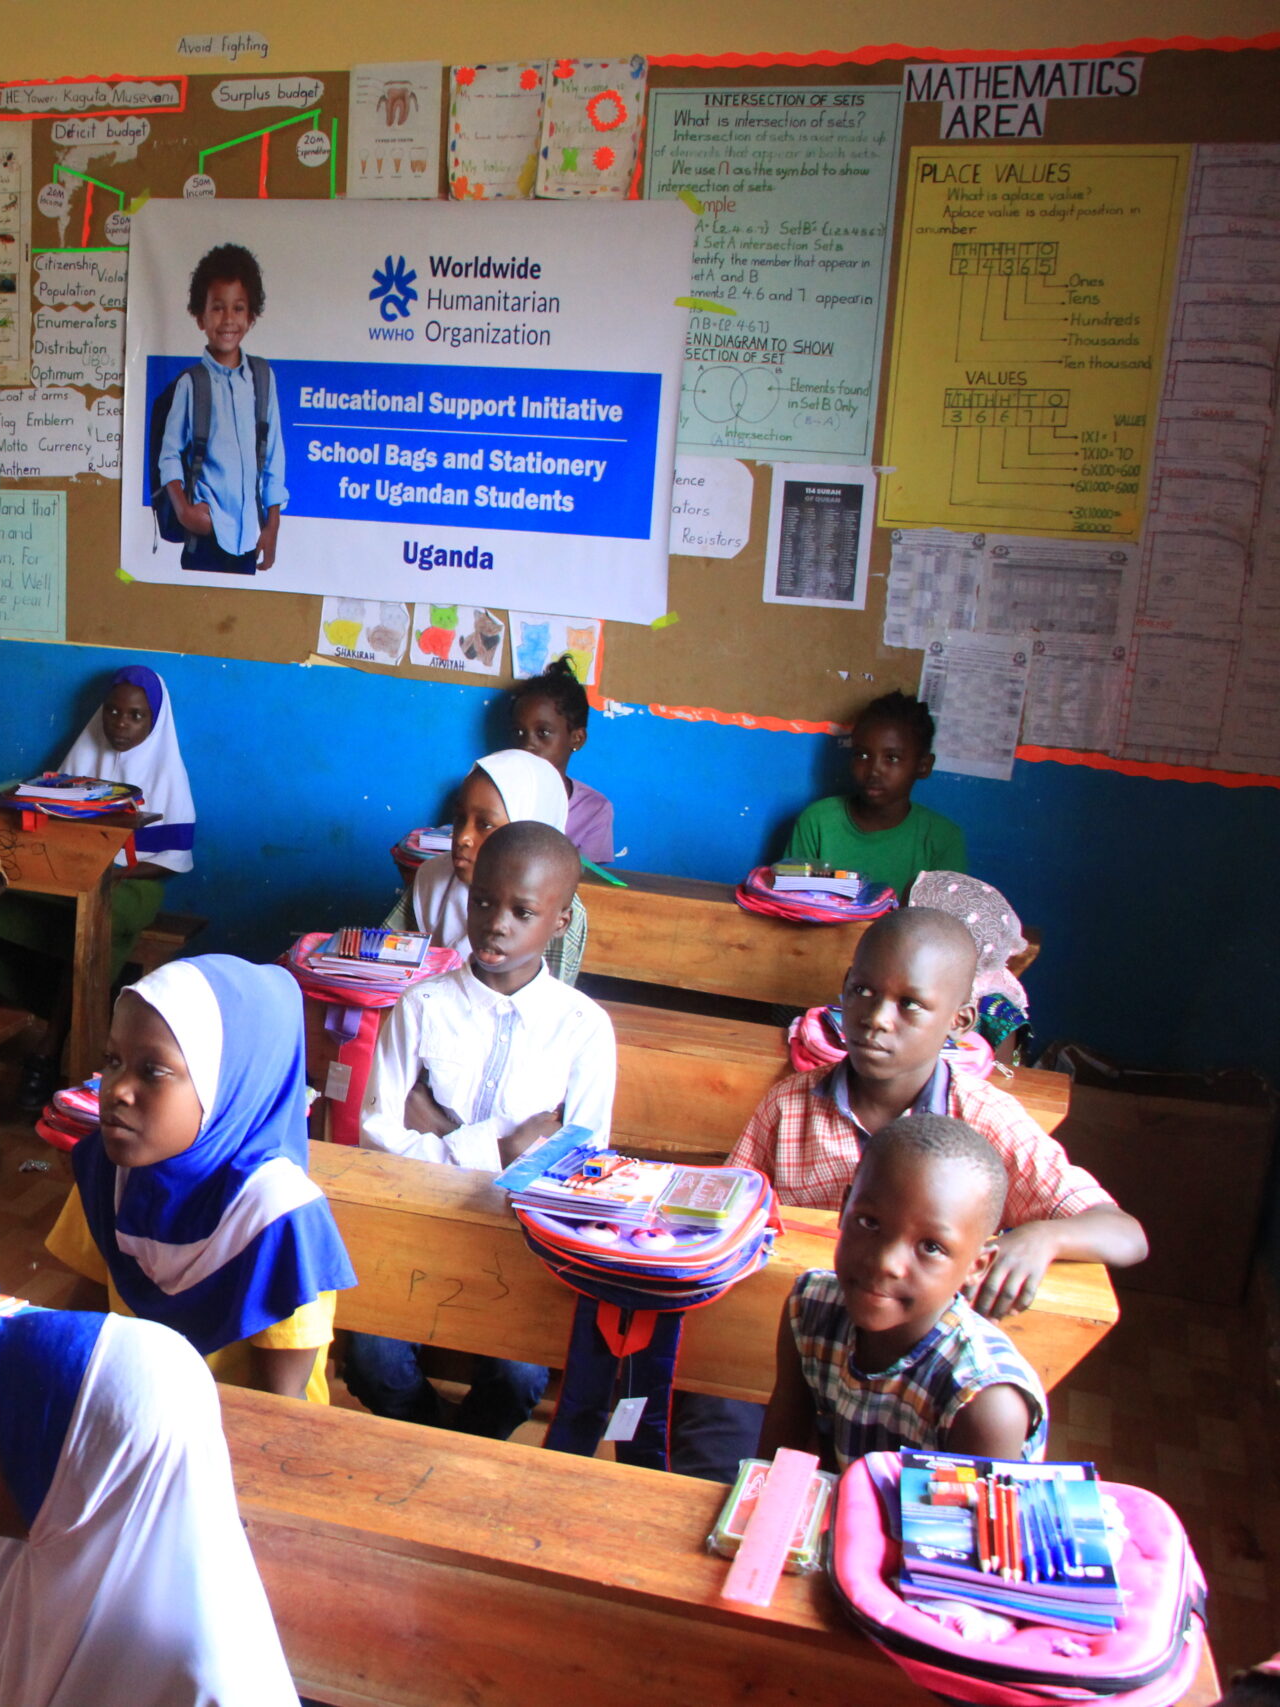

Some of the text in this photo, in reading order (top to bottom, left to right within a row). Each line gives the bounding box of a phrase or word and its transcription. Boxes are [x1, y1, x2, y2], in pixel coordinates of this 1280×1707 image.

[178, 38, 212, 53] Avoid
[906, 60, 1138, 101] MATHEMATICS
[64, 88, 107, 108] Kaguta
[220, 82, 319, 109] Surplus budget
[704, 94, 805, 107] INTERSECTION
[810, 94, 826, 106] OF
[673, 109, 709, 128] What
[718, 116, 729, 127] is
[734, 110, 806, 128] intersection
[945, 102, 1044, 138] AREA
[107, 120, 147, 145] budget
[672, 160, 691, 175] We
[695, 165, 716, 175] use
[775, 161, 819, 179] symbol
[920, 162, 1071, 184] PLACE VALUES
[948, 186, 984, 201] What
[35, 255, 98, 276] Citizenship
[429, 255, 542, 279] Worldwide
[731, 253, 747, 266] the
[751, 256, 792, 268] member
[794, 253, 816, 267] that
[818, 257, 859, 275] appear
[1069, 273, 1104, 287] Ones
[39, 281, 96, 302] Population
[427, 288, 560, 313] Humanitarian
[769, 288, 793, 301] and
[1067, 290, 1101, 305] Tens
[36, 314, 117, 329] Enumerators
[1070, 312, 1140, 327] Hundreds
[369, 327, 415, 341] WWHO
[425, 320, 551, 347] Organization
[1066, 333, 1140, 347] Thousands
[34, 340, 107, 355] Distribution
[714, 335, 834, 356] DIAGRAM TO SHOW
[743, 351, 757, 362] OF
[1063, 356, 1152, 370] Ten thousand
[31, 366, 84, 387] Optimum
[966, 371, 1028, 386] VALUES
[41, 392, 69, 401] arms
[299, 386, 623, 423] Educational Support Initiative
[26, 411, 74, 427] Emblem
[38, 437, 92, 455] Currency
[0, 463, 40, 476] Anthem
[307, 440, 607, 482] School Bags and Stationery
[338, 476, 575, 512] for Ugandan Students
[32, 498, 57, 516] that
[682, 527, 742, 548] Resistors
[402, 540, 494, 571] Uganda
[335, 647, 375, 660] SHAKIRAH
